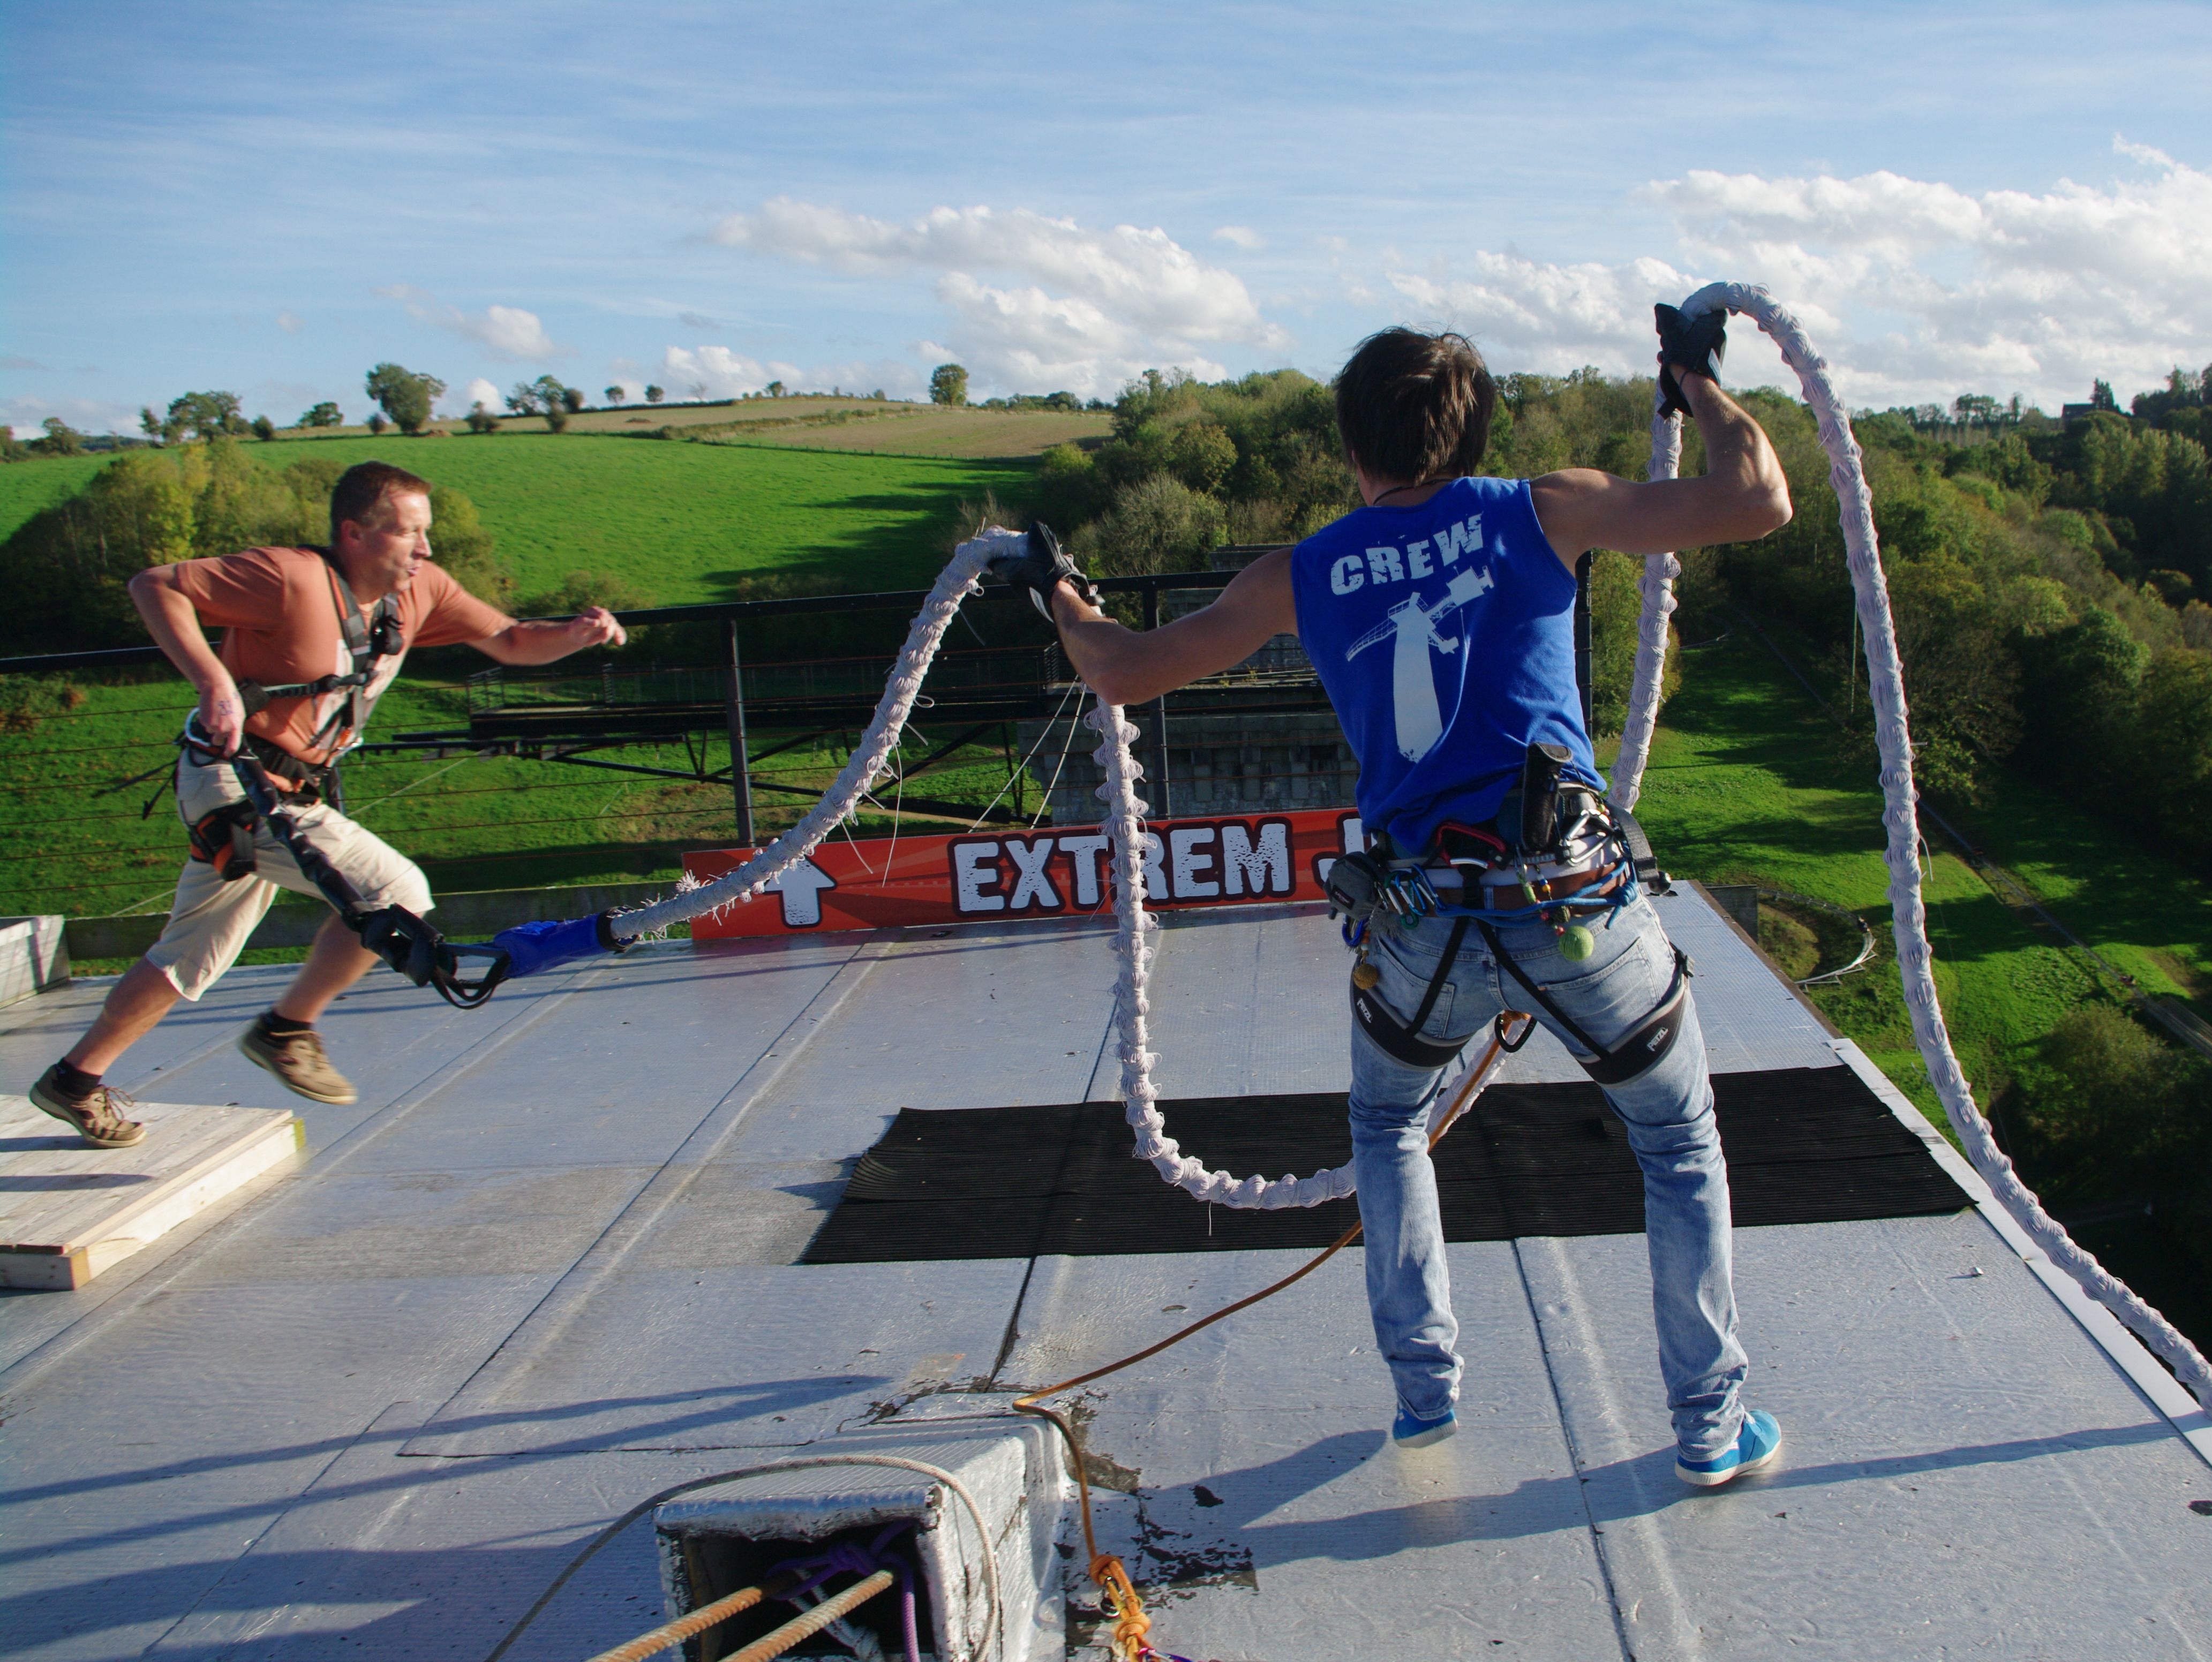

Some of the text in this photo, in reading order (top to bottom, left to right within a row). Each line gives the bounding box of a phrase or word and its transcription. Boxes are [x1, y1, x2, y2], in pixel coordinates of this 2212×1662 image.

[1330, 512, 1484, 595] CREW
[1357, 998, 1372, 1023] PETZL
[1646, 1027, 1669, 1052] PETZL
